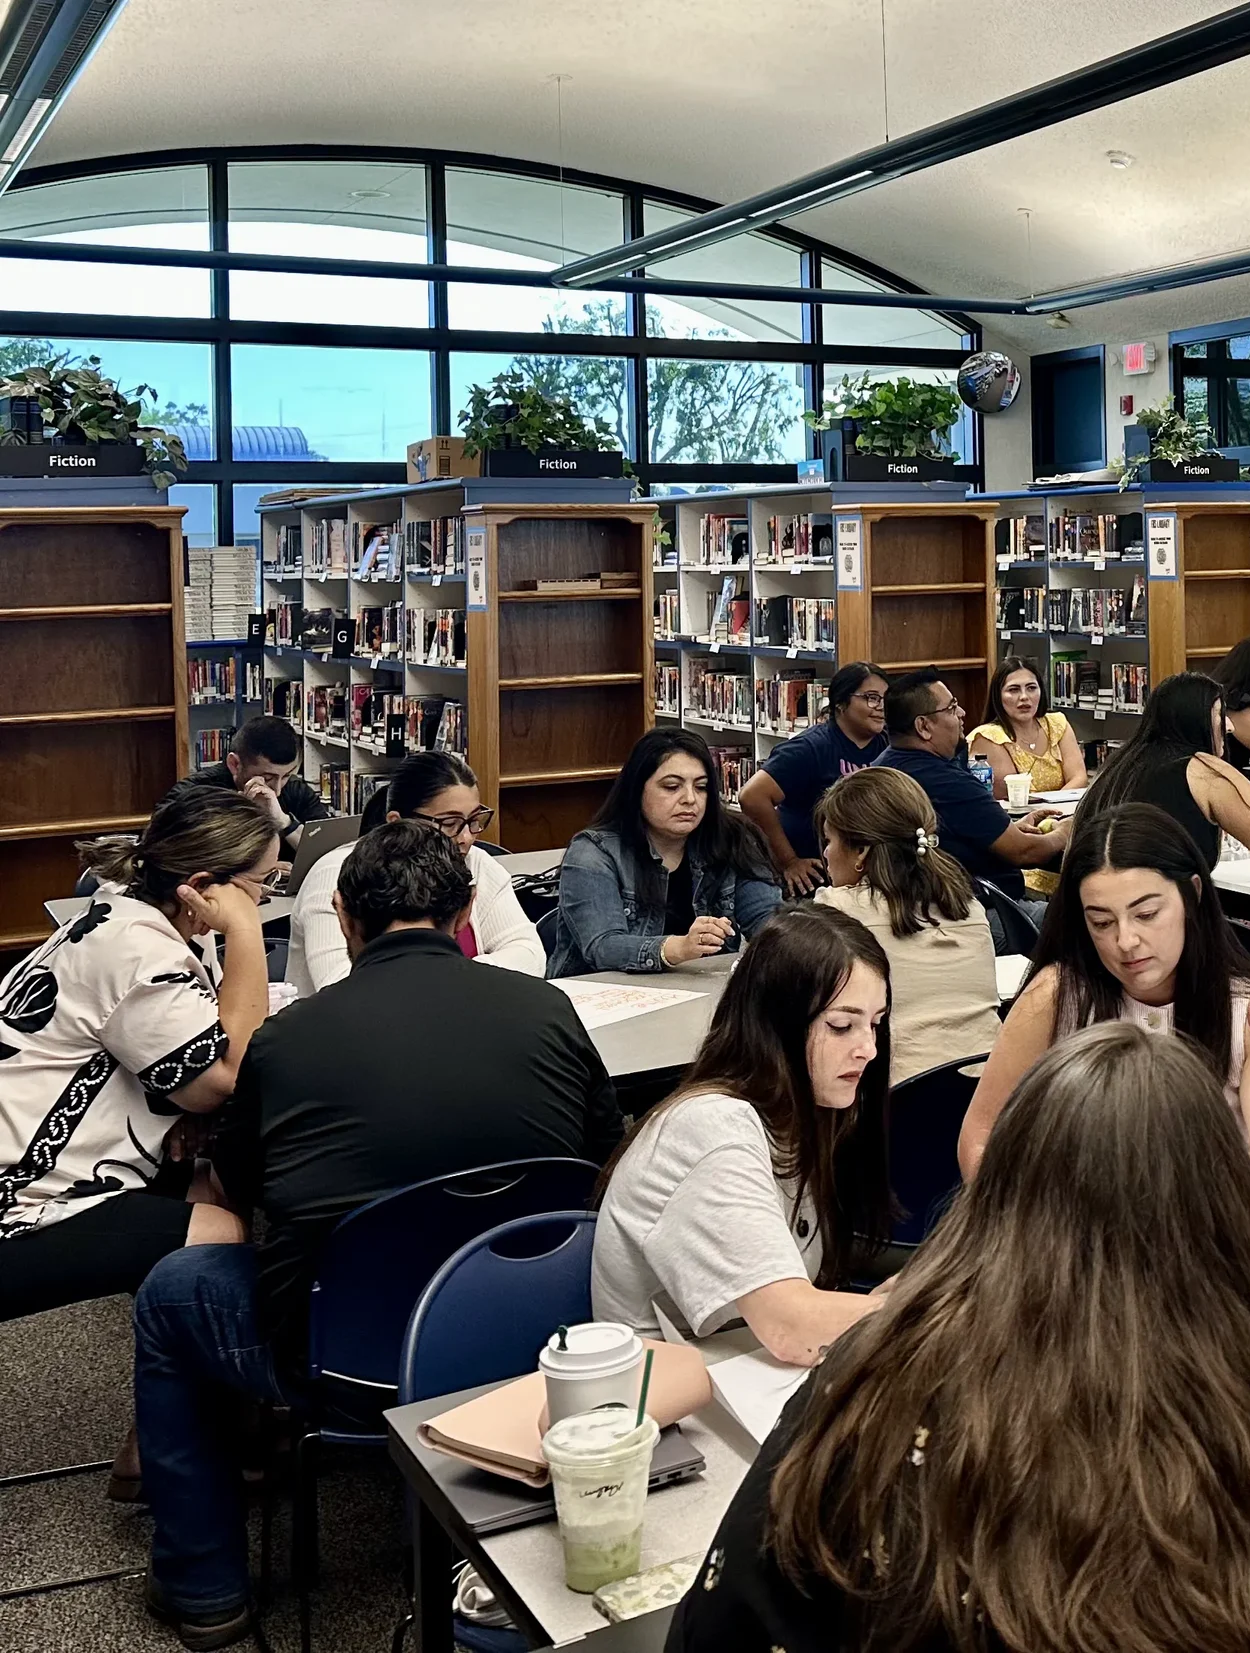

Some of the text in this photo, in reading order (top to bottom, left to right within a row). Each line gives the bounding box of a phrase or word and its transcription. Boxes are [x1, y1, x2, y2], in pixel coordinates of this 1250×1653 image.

[49, 455, 96, 467] Fiction
[539, 459, 577, 470] Fiction
[887, 463, 918, 474] Fiction
[1184, 466, 1210, 475] Fiction
[252, 624, 260, 635] E
[337, 630, 348, 643] G
[391, 727, 402, 741] H
